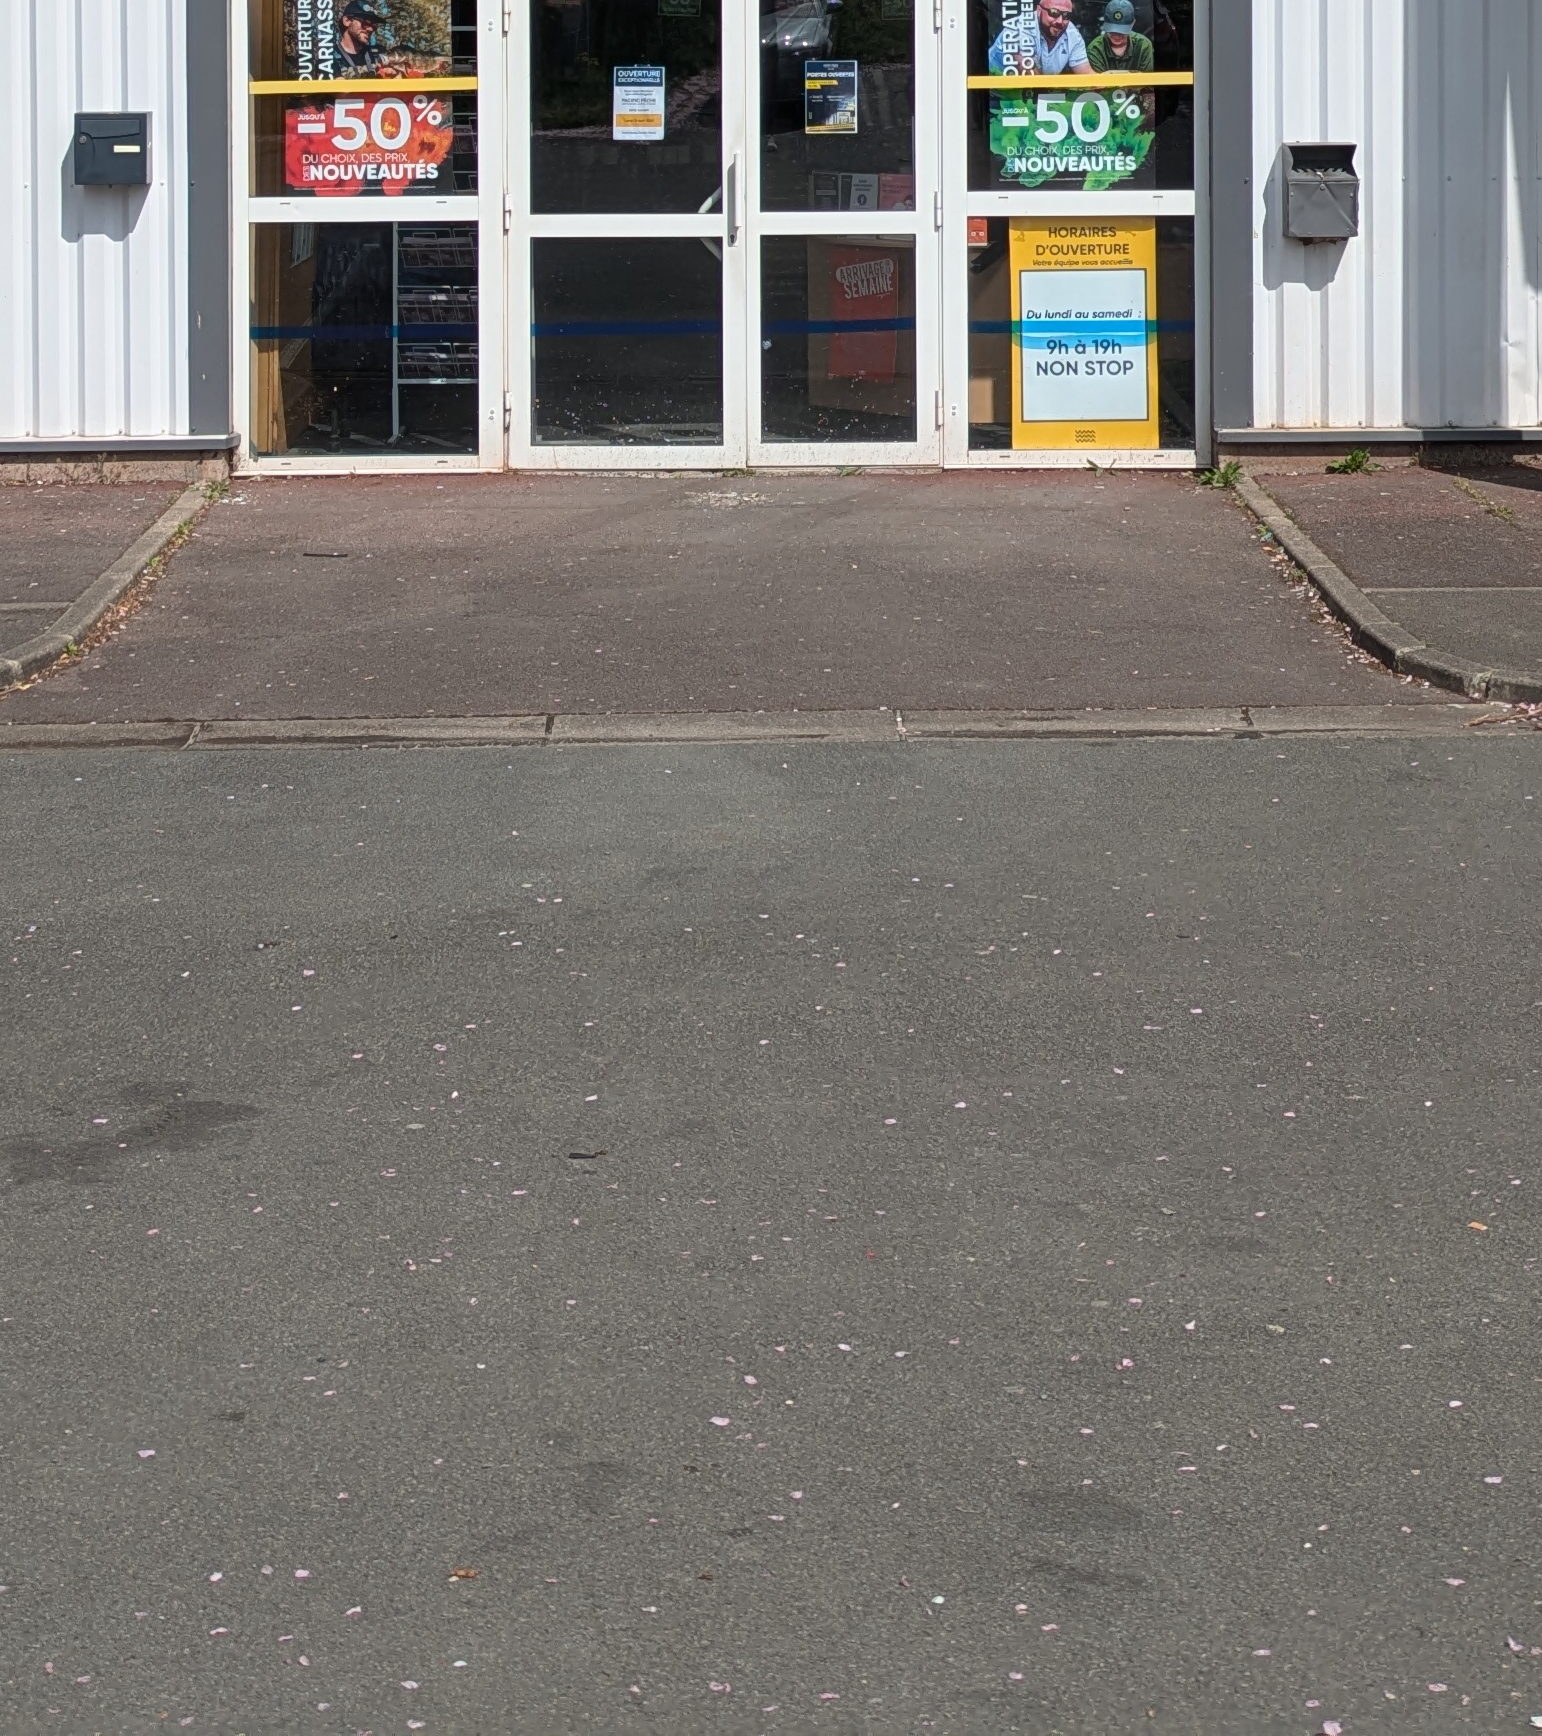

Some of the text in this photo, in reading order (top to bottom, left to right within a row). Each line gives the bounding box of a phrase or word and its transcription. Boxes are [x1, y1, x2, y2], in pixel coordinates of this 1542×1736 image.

[618, 70, 661, 78] OUVERTURE
[297, 94, 442, 151] -50%
[1002, 89, 1141, 143] -50%
[302, 153, 411, 164] DU CHOIX, DES PRIX,
[1007, 145, 1110, 156] DU CHOIX, DES PRIX,
[310, 159, 439, 181] NOUVEAUTÉS
[1014, 152, 1137, 173] NOUVEAUTÉS
[1048, 226, 1117, 239] HORAIRES
[1035, 243, 1130, 256] D'OUVERTURE
[843, 273, 893, 299] SEMAINE
[1026, 309, 1042, 320] Du
[1044, 309, 1072, 319] lundi
[1074, 310, 1089, 319] au
[1092, 308, 1133, 319] samedi
[1046, 338, 1122, 355] 9h à 19h
[1036, 359, 1134, 376] NON STOP
